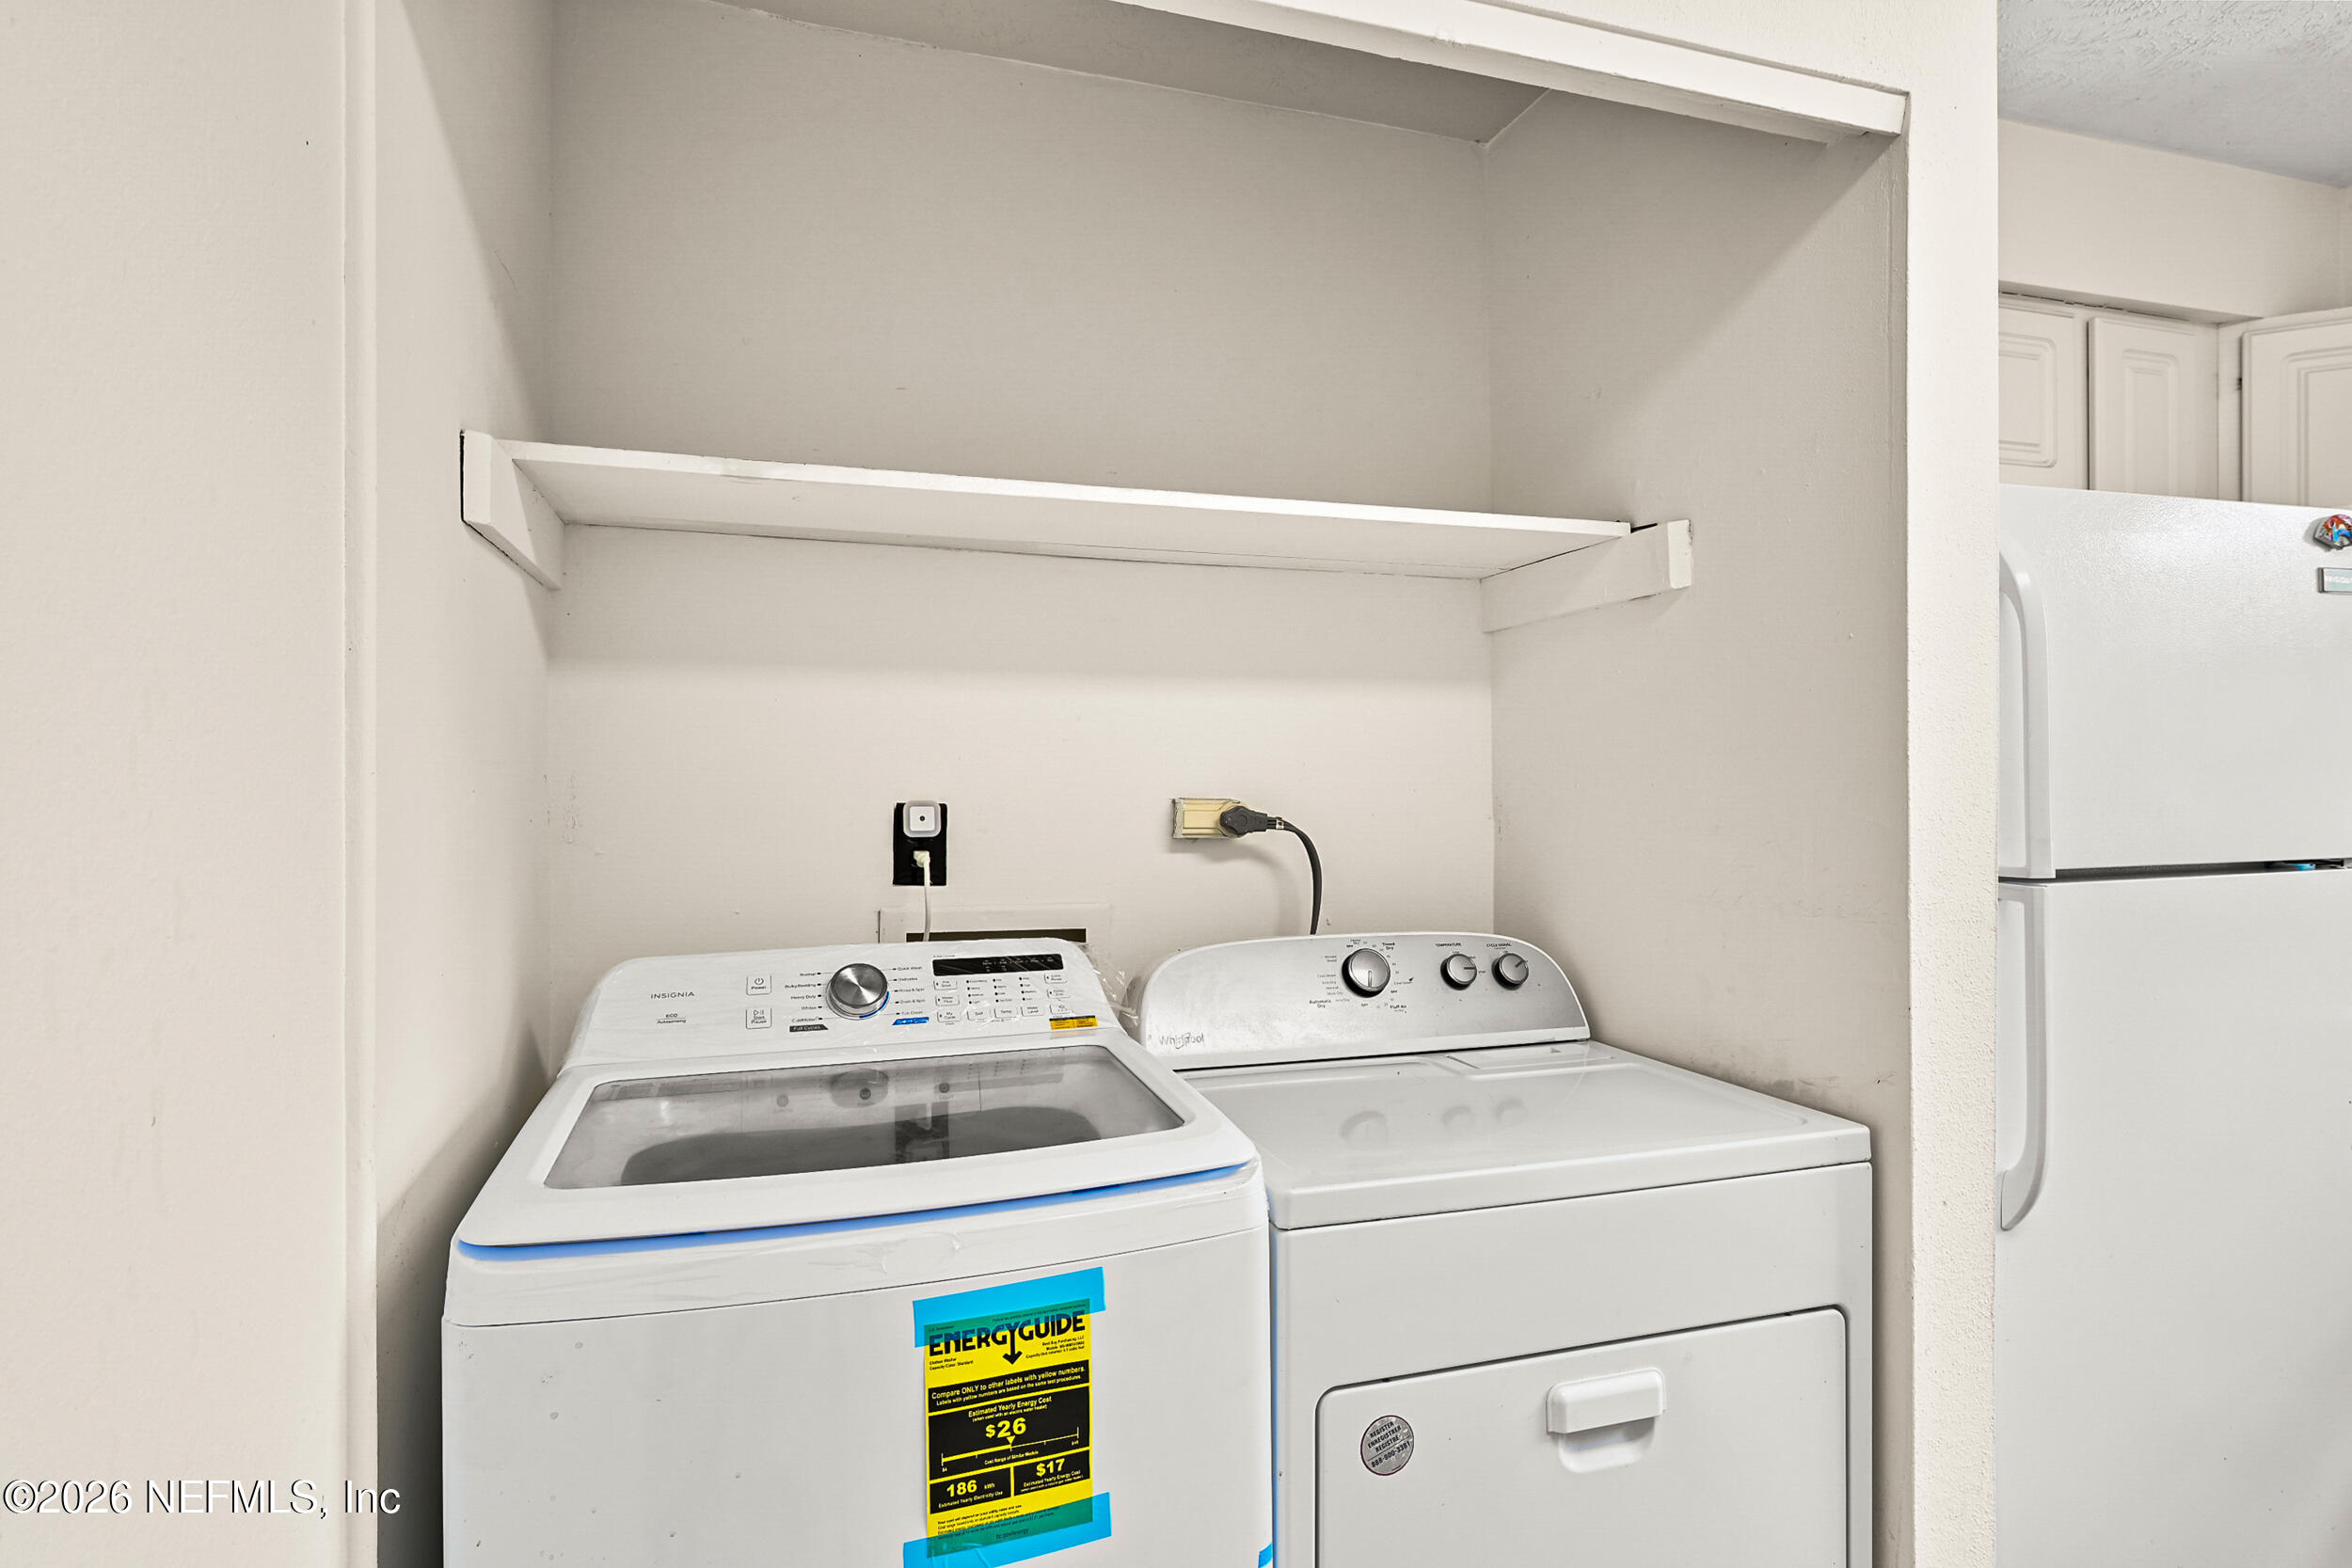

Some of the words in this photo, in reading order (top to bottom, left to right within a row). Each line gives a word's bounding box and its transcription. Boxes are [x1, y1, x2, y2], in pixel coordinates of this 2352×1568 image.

[1159, 1032, 1204, 1049] Whirlpool
[930, 1309, 1085, 1363] ENERGYGUIDE
[931, 1389, 960, 1399] Compare
[961, 1385, 978, 1394] ONLY
[988, 1381, 1004, 1389] other
[1005, 1377, 1023, 1386] labels
[1024, 1373, 1037, 1382] with
[1038, 1370, 1057, 1380] yellow
[1058, 1366, 1086, 1375] numbers.
[968, 1405, 997, 1418] Estimated
[998, 1402, 1016, 1411] Yearly
[1017, 1400, 1037, 1408] Energy
[986, 1418, 1026, 1438] $26
[1368, 1425, 1401, 1449] ENREGISTRER
[1370, 1421, 1393, 1438] REGISTER
[1375, 1434, 1399, 1452] REGISTRE
[1036, 1458, 1065, 1477] $17
[946, 1480, 977, 1497] 186
[1024, 1479, 1043, 1487] Estimated
[938, 1499, 959, 1509] Estimated
